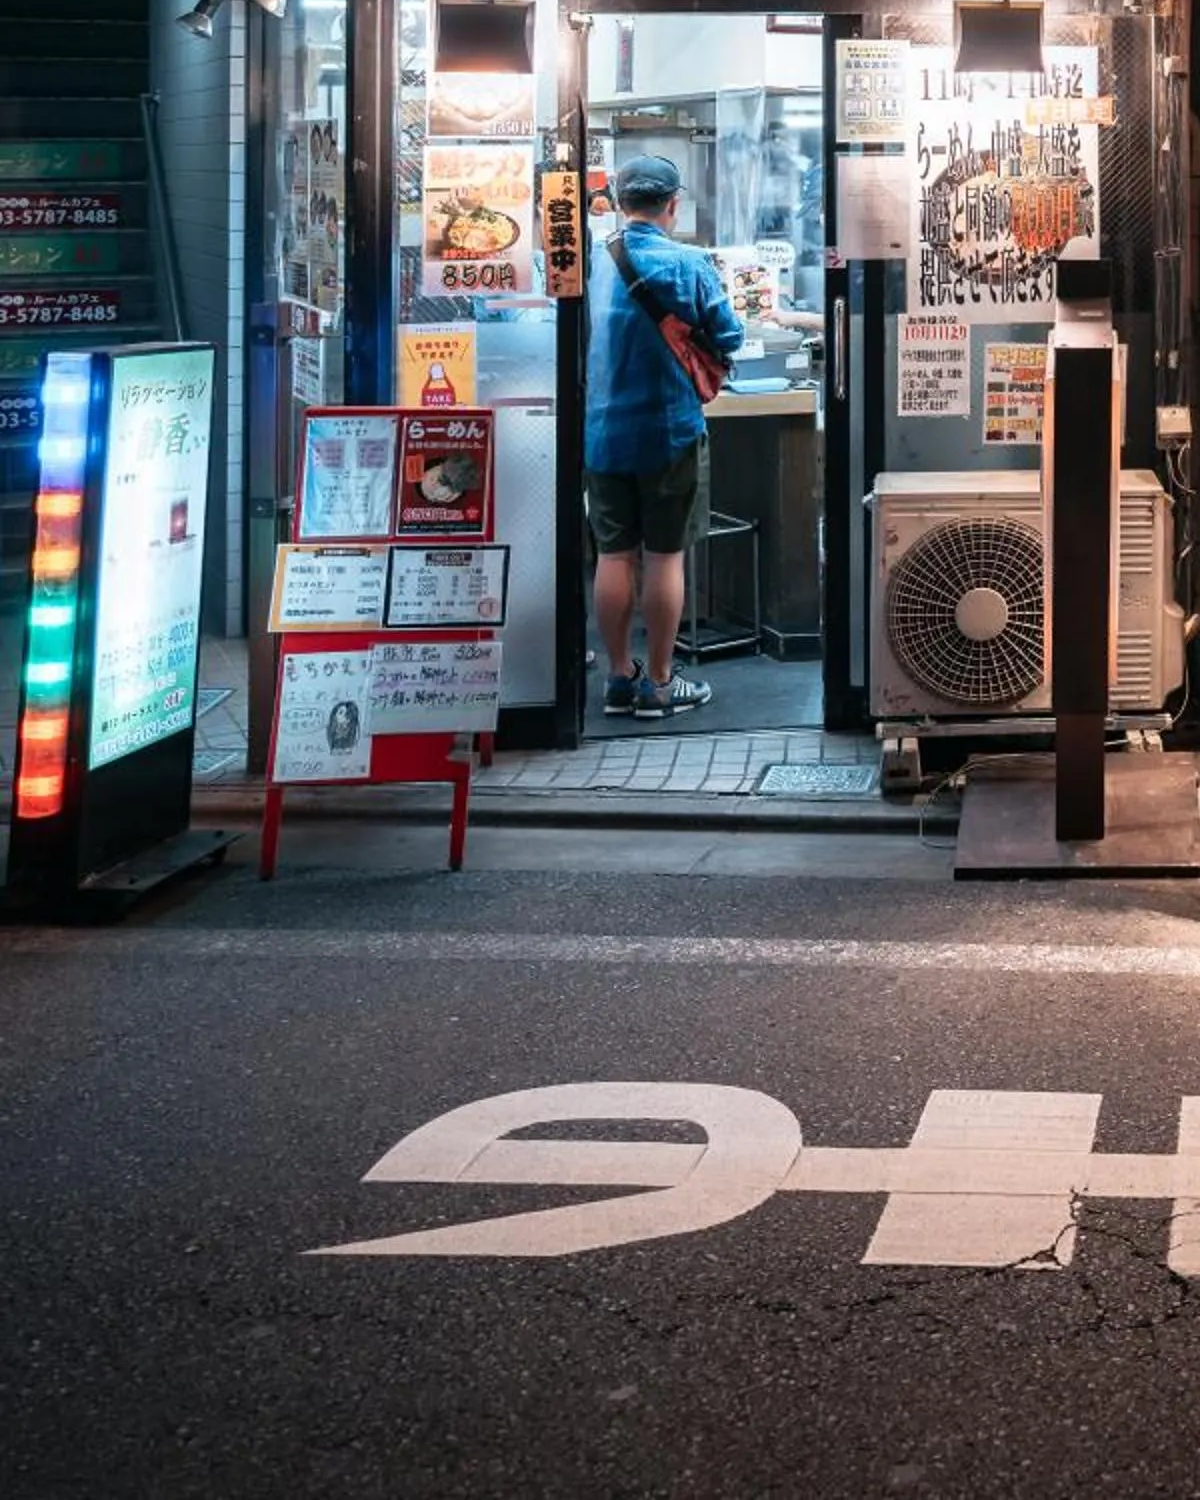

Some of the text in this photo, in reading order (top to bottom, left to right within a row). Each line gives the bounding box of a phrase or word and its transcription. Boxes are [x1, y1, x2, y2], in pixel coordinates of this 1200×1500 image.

[0, 209, 118, 225] 3-5787-8485
[409, 420, 486, 440] らーめん
